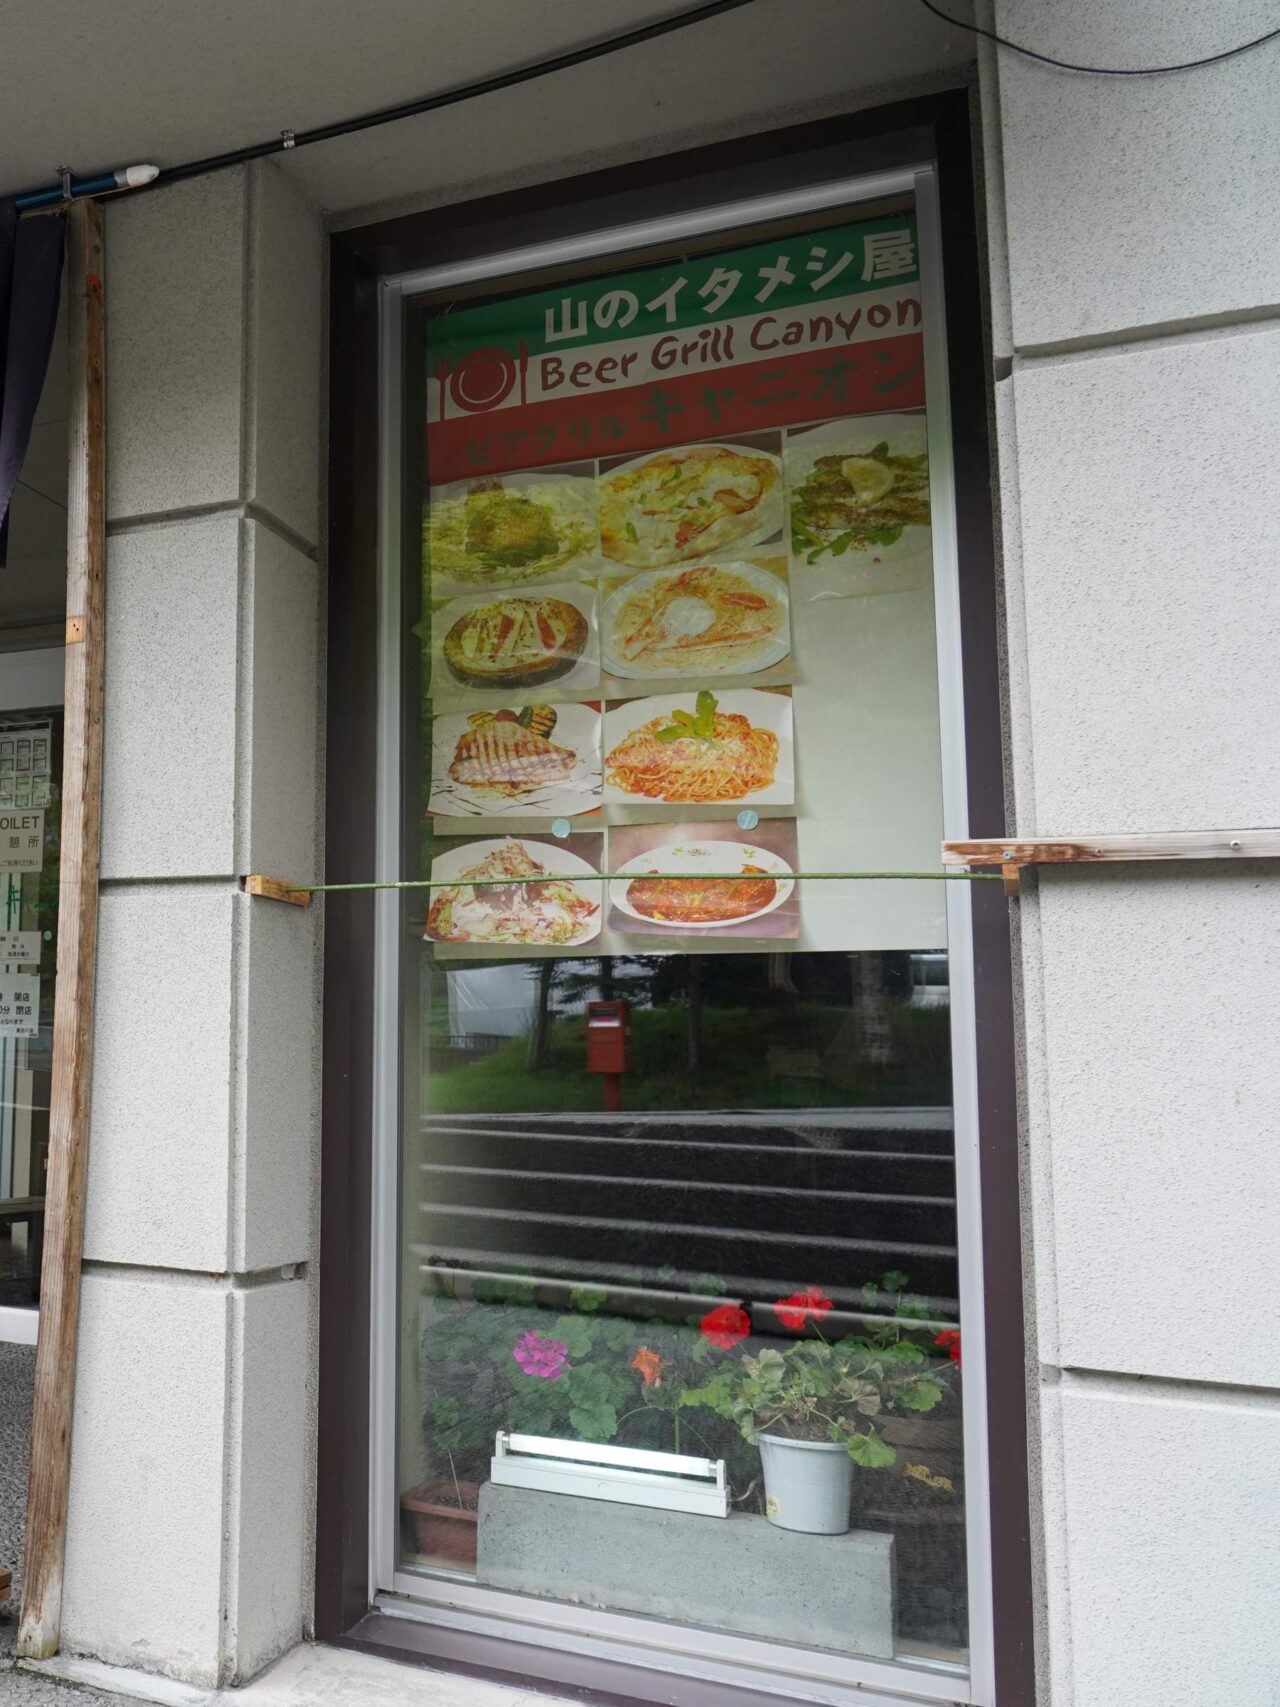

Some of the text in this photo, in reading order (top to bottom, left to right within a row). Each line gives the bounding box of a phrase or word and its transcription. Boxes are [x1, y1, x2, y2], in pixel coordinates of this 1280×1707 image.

[544, 229, 917, 344] 山のイタメシ屋
[540, 297, 922, 392] Beer Grill Canyon
[14, 992, 30, 1002] 開店
[16, 1006, 32, 1016] 閉店
